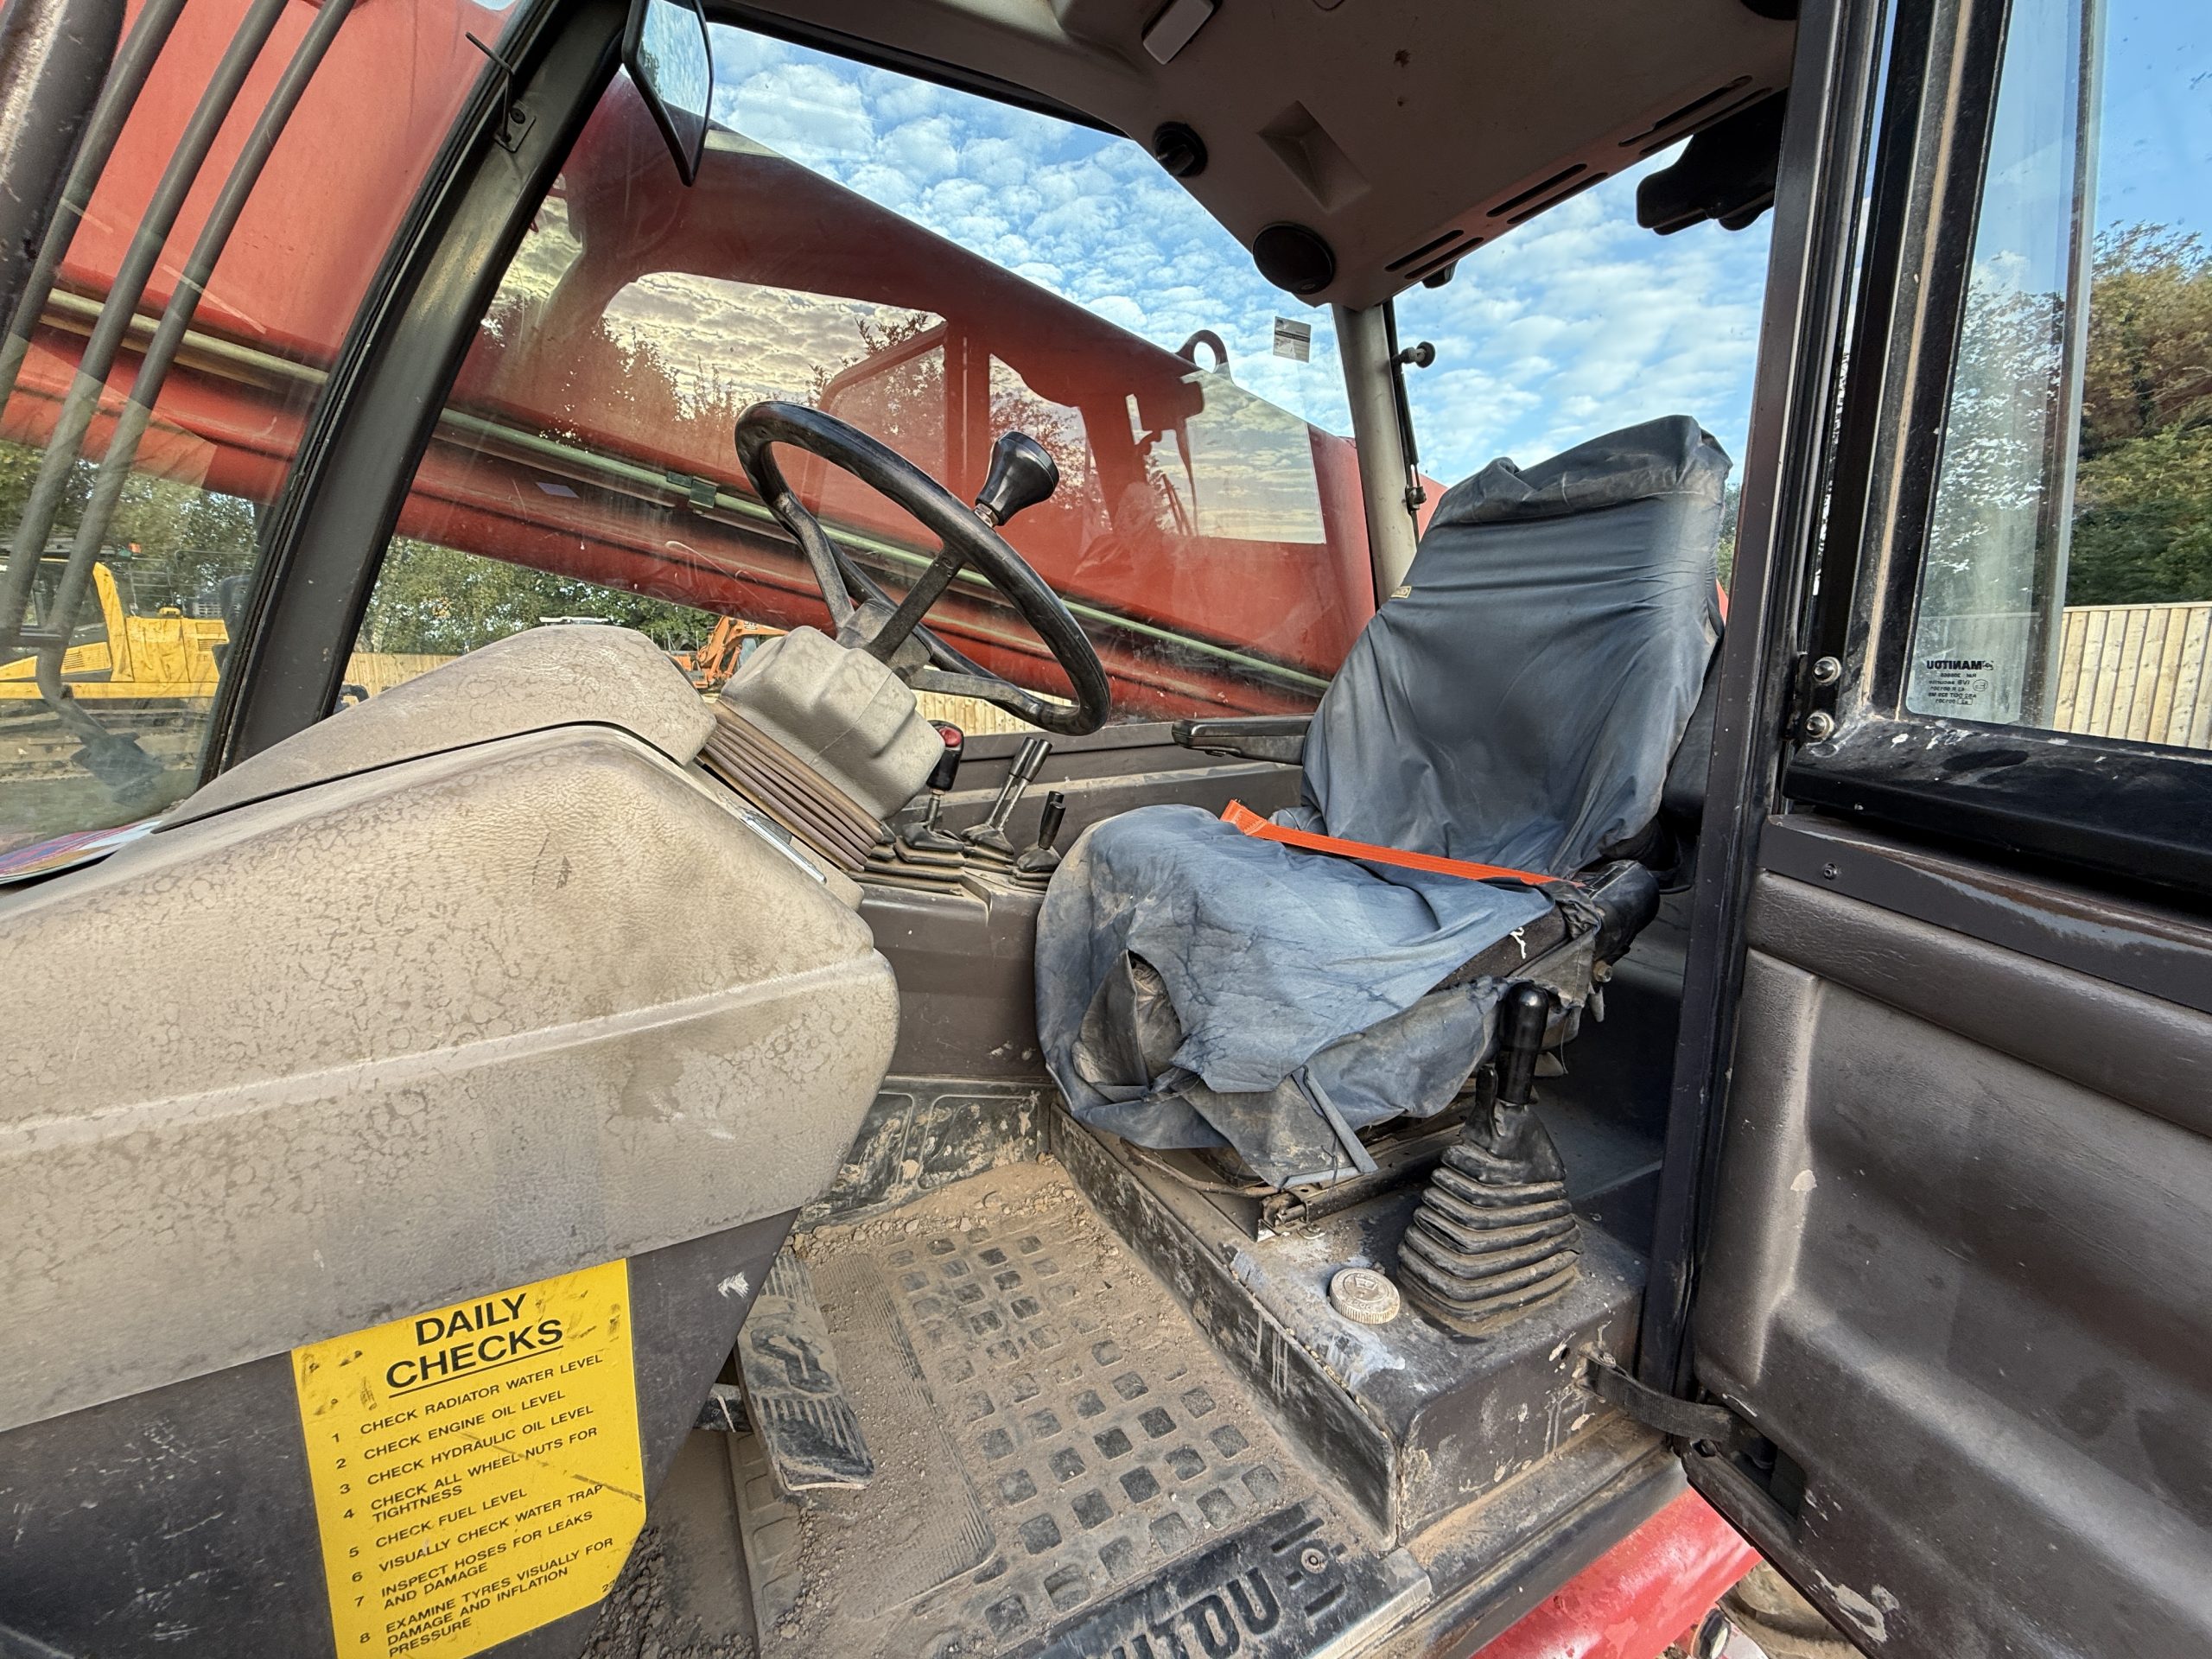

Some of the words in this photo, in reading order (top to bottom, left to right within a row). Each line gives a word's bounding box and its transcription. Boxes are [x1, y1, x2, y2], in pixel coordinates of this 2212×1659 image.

[386, 1319, 563, 1389] CHECKS
[416, 1293, 526, 1346] DAILY
[332, 1433, 339, 1442] 1
[360, 1409, 418, 1434] CHECK
[425, 1384, 499, 1415] RADIATOR
[506, 1369, 553, 1389] WATER
[560, 1355, 603, 1374] LEVEL
[336, 1459, 346, 1469] 2
[364, 1434, 421, 1459] CHECK
[429, 1414, 485, 1440] ENGINE
[492, 1406, 516, 1419] OIL
[522, 1390, 565, 1410] LEVEL
[340, 1484, 351, 1494] 3
[367, 1459, 424, 1484] CHECK
[431, 1430, 516, 1465] HYDRAULIC
[522, 1421, 545, 1434] OIL
[551, 1406, 594, 1426] LEVEL
[343, 1509, 354, 1518] 4
[371, 1484, 427, 1510] CHECK
[435, 1473, 462, 1490] ALL
[467, 1453, 520, 1477] WHEEL
[525, 1439, 563, 1459] NUTS
[569, 1427, 597, 1444] FOR
[349, 1547, 359, 1558] 5
[376, 1521, 432, 1548] CHECK
[439, 1507, 476, 1526] FUEL
[482, 1489, 527, 1510] LEVEL
[352, 1572, 363, 1582] 6
[378, 1538, 450, 1572] VISUALLY
[457, 1517, 509, 1543] CHECK
[515, 1499, 562, 1522] WATER
[567, 1483, 603, 1503] TRAP
[372, 1485, 462, 1522] TIGHTNESS
[354, 1596, 365, 1607] 7
[382, 1564, 448, 1597] INSPECT
[454, 1543, 506, 1569] HOSES
[513, 1530, 542, 1548] FOR
[548, 1511, 593, 1535] LEAKS
[360, 1632, 371, 1643] 8
[386, 1599, 455, 1633] EXAMINE
[461, 1578, 511, 1602] TYRES
[517, 1550, 579, 1580] VISUALLY
[586, 1538, 613, 1555] FOR
[385, 1590, 416, 1610] AND
[424, 1562, 487, 1594] DAMAGE
[388, 1612, 453, 1646] DAMAGE
[460, 1599, 490, 1617] AND
[497, 1567, 568, 1602] INFLATION
[389, 1617, 471, 1657] PRESSURE
